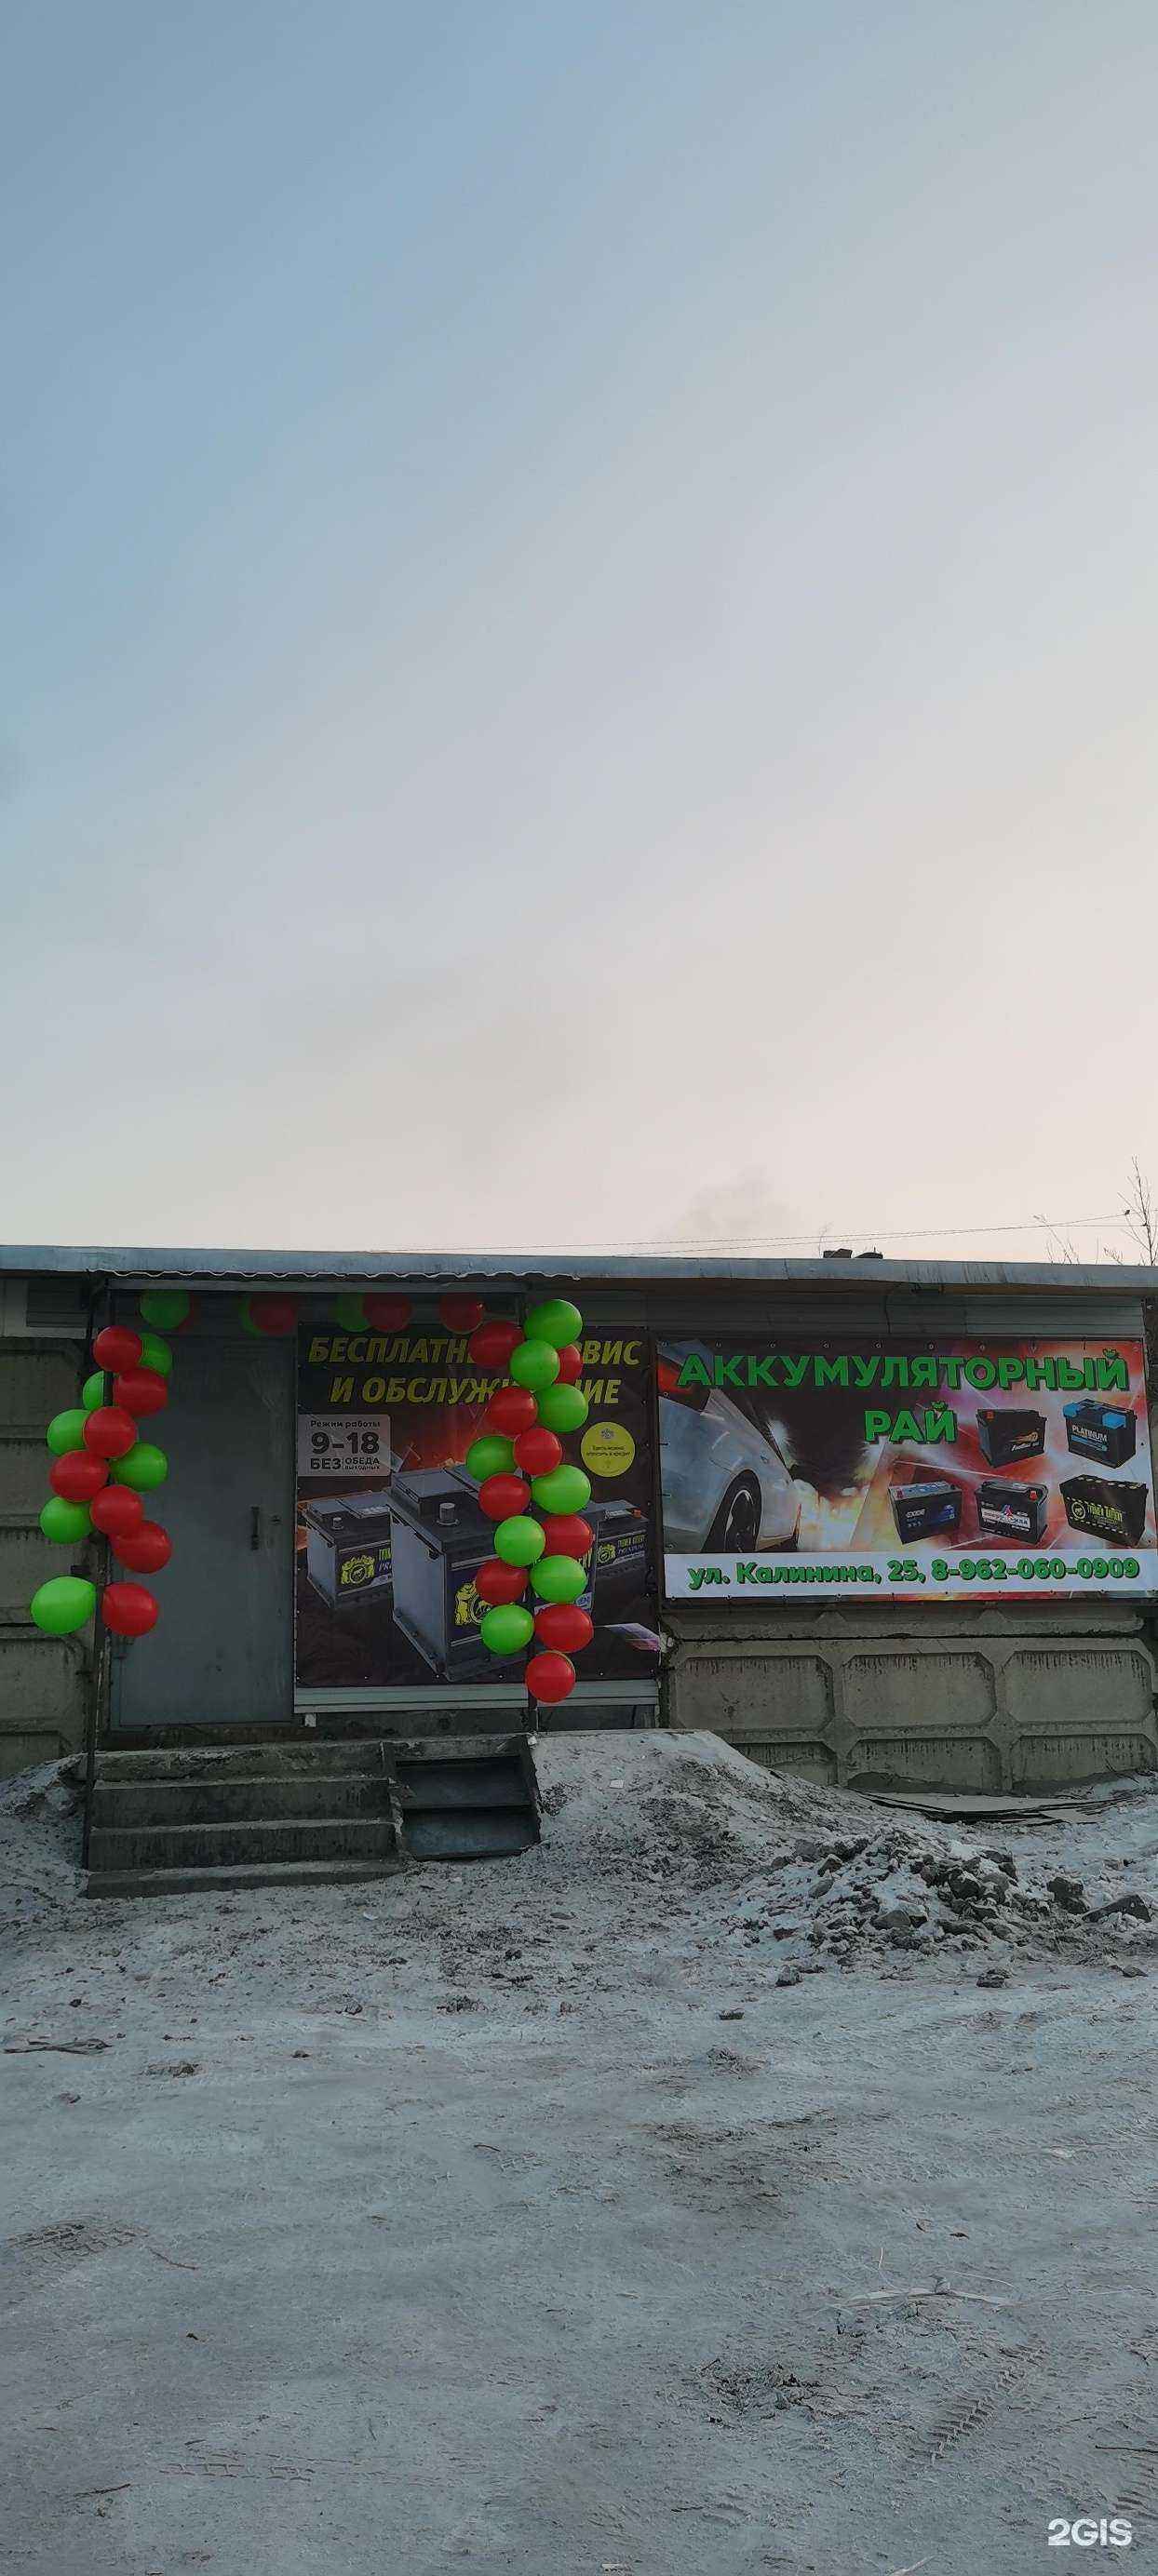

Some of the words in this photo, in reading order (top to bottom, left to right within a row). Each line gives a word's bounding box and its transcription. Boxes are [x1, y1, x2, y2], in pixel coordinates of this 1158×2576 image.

[308, 1336, 478, 1364] БЕСПЛАТН
[677, 1348, 1129, 1391] АККУМУЛЯТОРНЫЙ
[330, 1376, 355, 1404] И
[864, 1401, 958, 1443] РАЙ
[311, 1431, 380, 1455] 9-18
[310, 1457, 342, 1470] БЕЗ
[344, 1456, 381, 1465] ОБЕДА
[687, 1566, 731, 1590] ул.
[735, 1562, 882, 1585] Калинина,
[887, 1559, 927, 1584] 25,
[931, 1557, 1141, 1581] 8-962-060-0909
